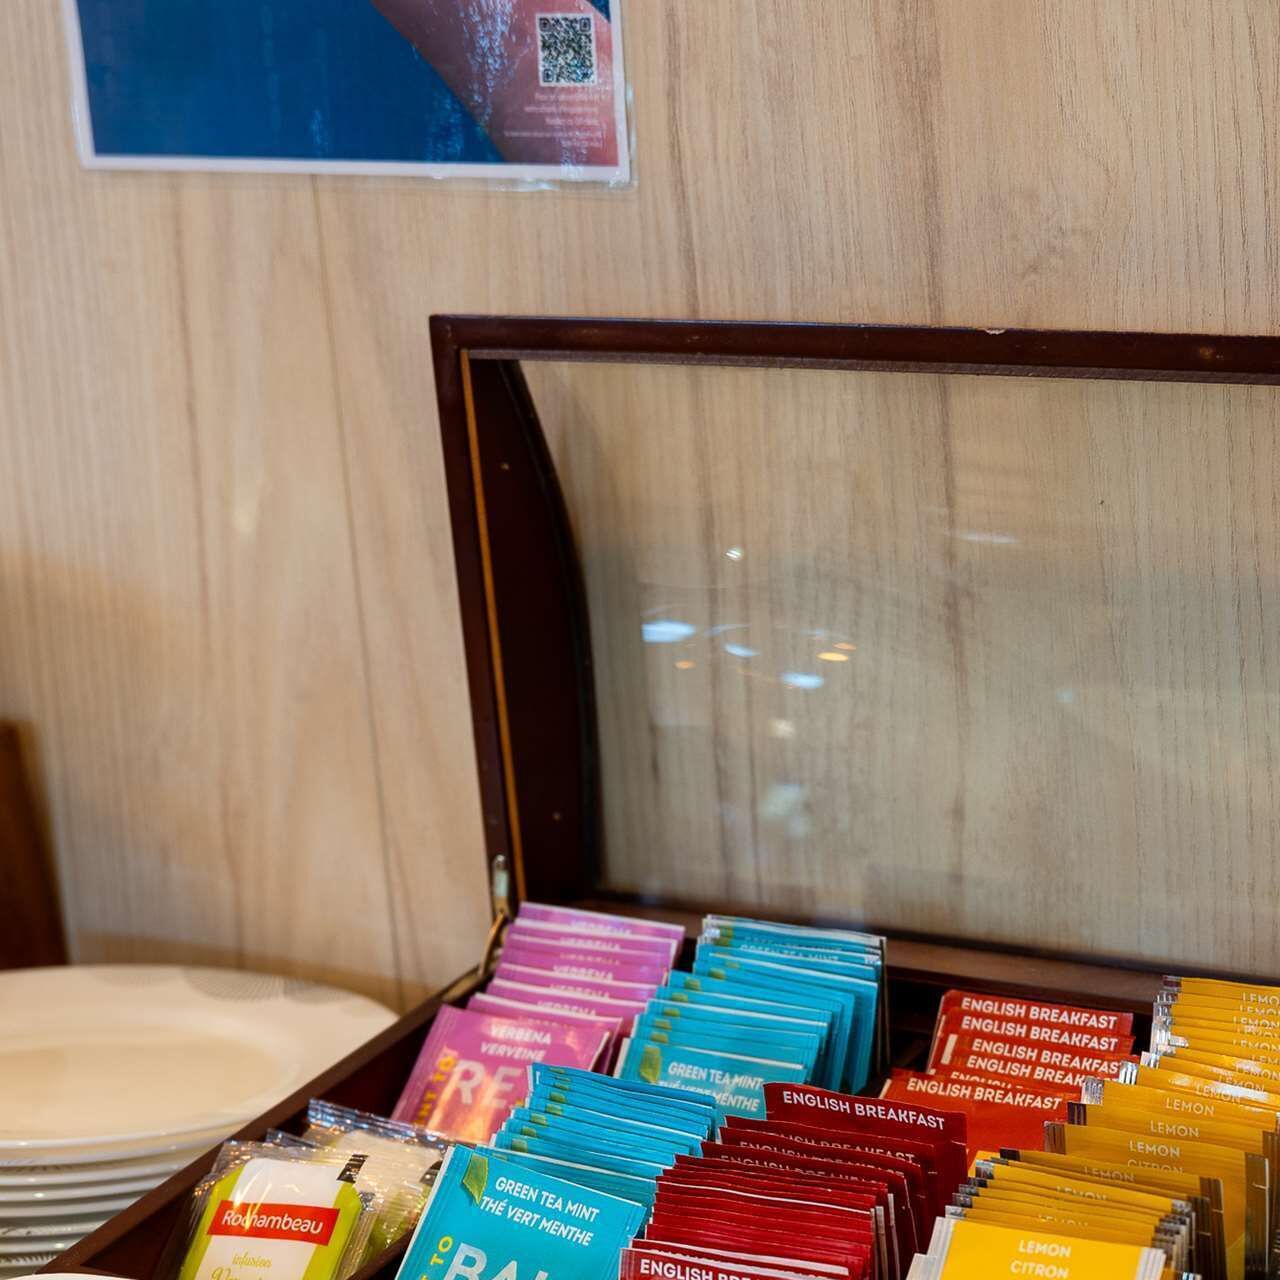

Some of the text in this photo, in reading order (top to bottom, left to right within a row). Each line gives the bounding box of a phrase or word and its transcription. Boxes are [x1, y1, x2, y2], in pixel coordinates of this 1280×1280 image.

[961, 997, 1118, 1030] ENGLISH BREAKFAST
[489, 1023, 552, 1045] VERBENA
[961, 1015, 1119, 1051] ENGLISH BREAKFAST
[480, 1042, 546, 1062] VERVEINE
[972, 1037, 1119, 1075] ENGLISH BREAKFAS
[668, 1061, 708, 1081] GREEN
[709, 1068, 730, 1086] TEA
[732, 1073, 764, 1092] MINT
[966, 1055, 1086, 1087] ENGLISH BREAK
[711, 1091, 760, 1113] MENTHE
[906, 1077, 1063, 1111] ENGLISH BREAKFAST
[1165, 1097, 1215, 1116] LEMON
[783, 1090, 945, 1131] ENGLISH BREAKFAST
[1150, 1119, 1200, 1138] LEMON
[1129, 1139, 1180, 1158] LEMON
[495, 1176, 600, 1223] GREEN TEA MINT
[221, 1209, 324, 1235] Rochambeau
[480, 1195, 595, 1246] THÉ VERT MENTHE
[429, 1235, 454, 1266] TO
[1017, 1239, 1072, 1259] LEMON
[1009, 1260, 1070, 1280] CITRON
